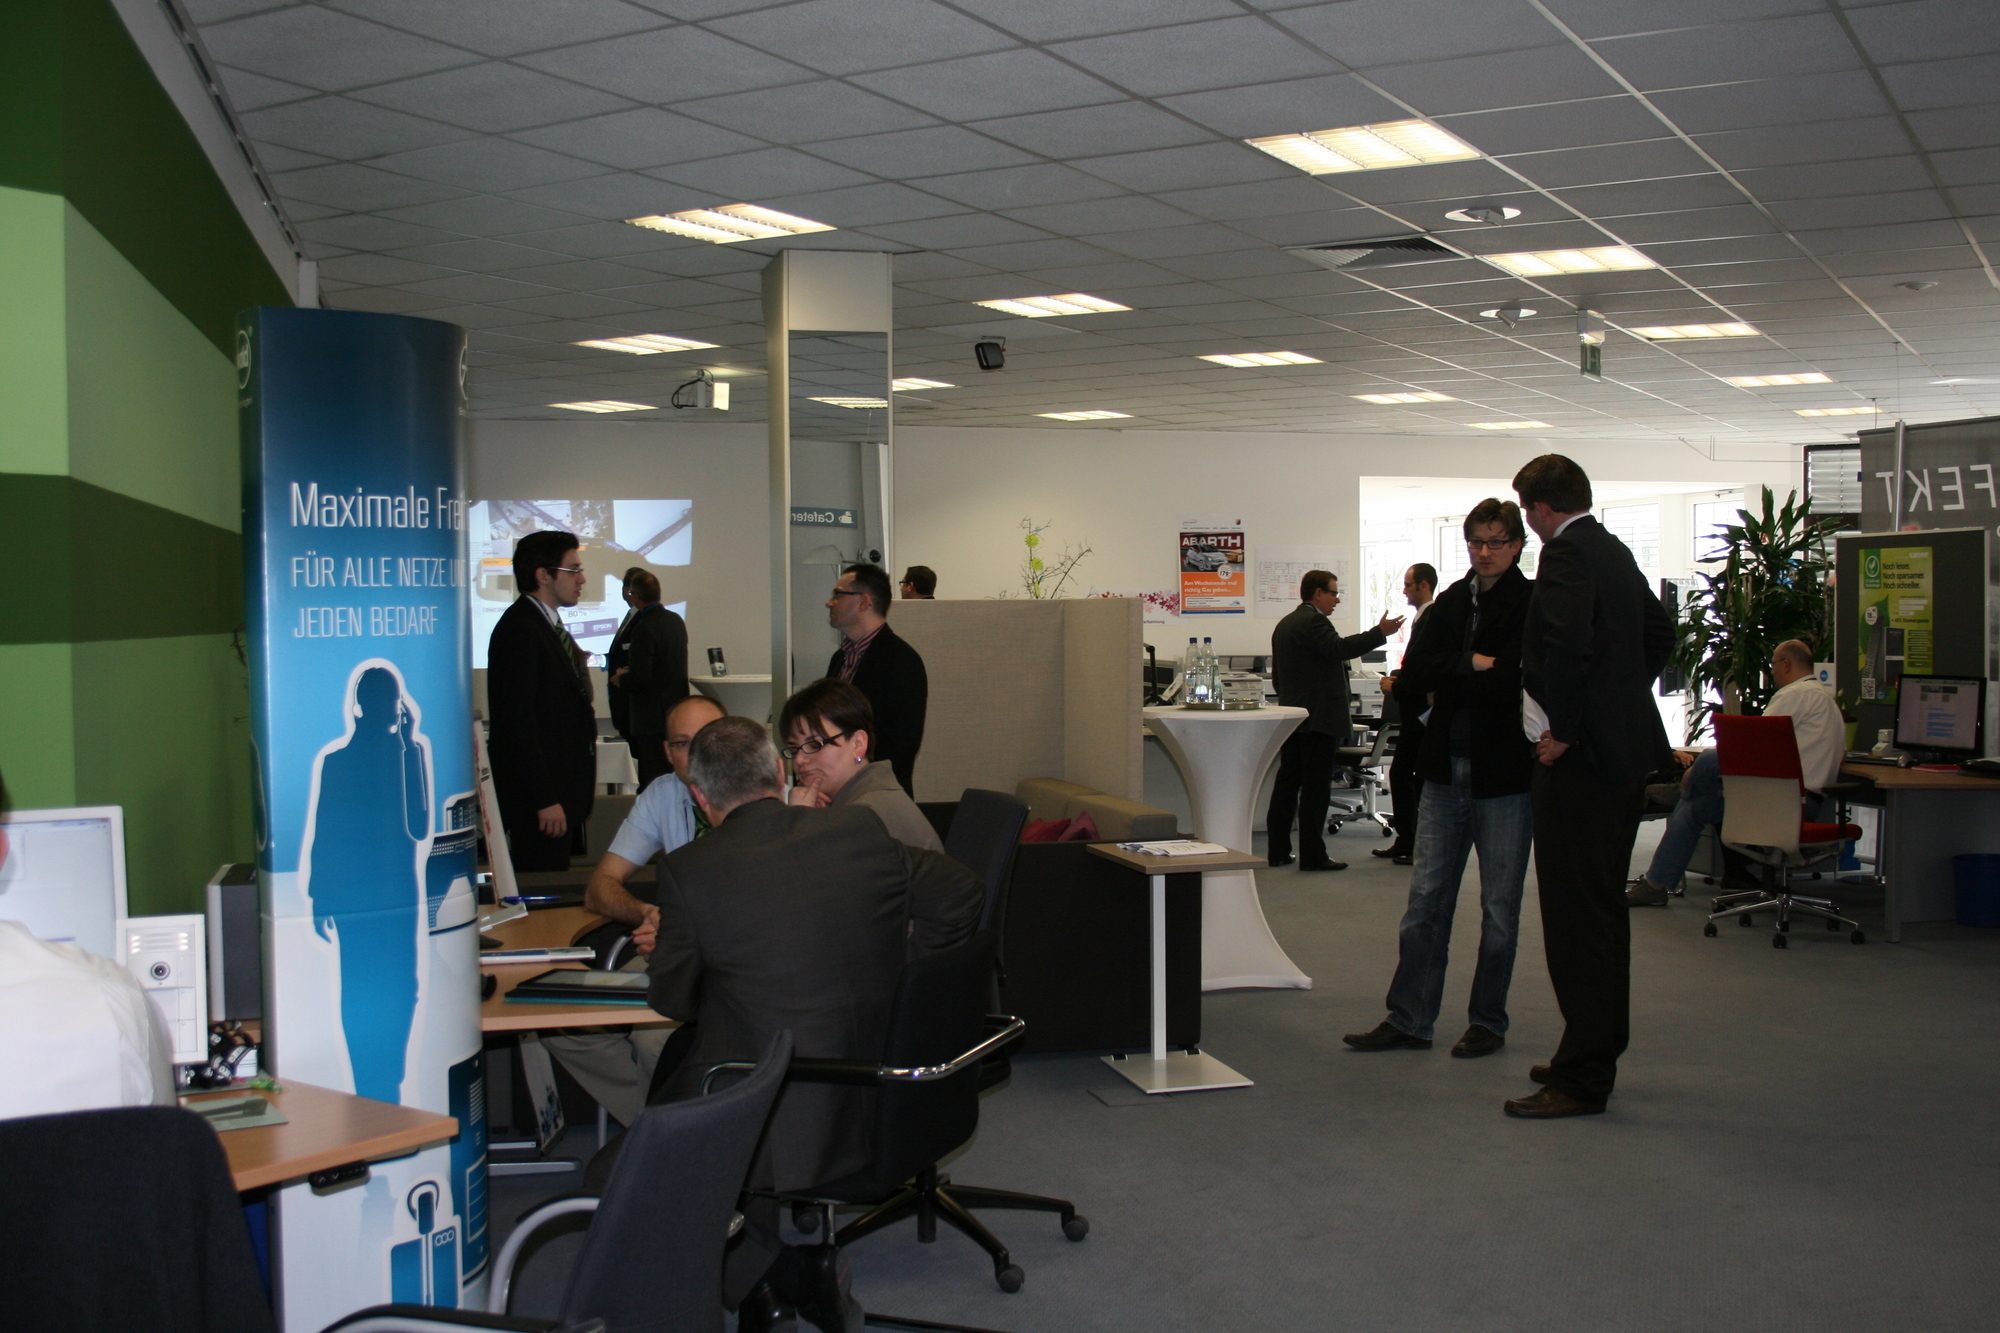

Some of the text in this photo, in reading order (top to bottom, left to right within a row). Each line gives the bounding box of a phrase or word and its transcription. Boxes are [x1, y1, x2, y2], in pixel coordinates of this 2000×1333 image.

[291, 481, 429, 529] Maximale
[1182, 535, 1241, 547] ABARTH
[292, 551, 336, 588] FÜR
[342, 557, 393, 587] ALLE
[398, 557, 447, 587] NETZE
[1896, 572, 1925, 580] sparsamer.
[293, 605, 439, 638] JEDEN BEDARF
[593, 623, 613, 631] EPSON
